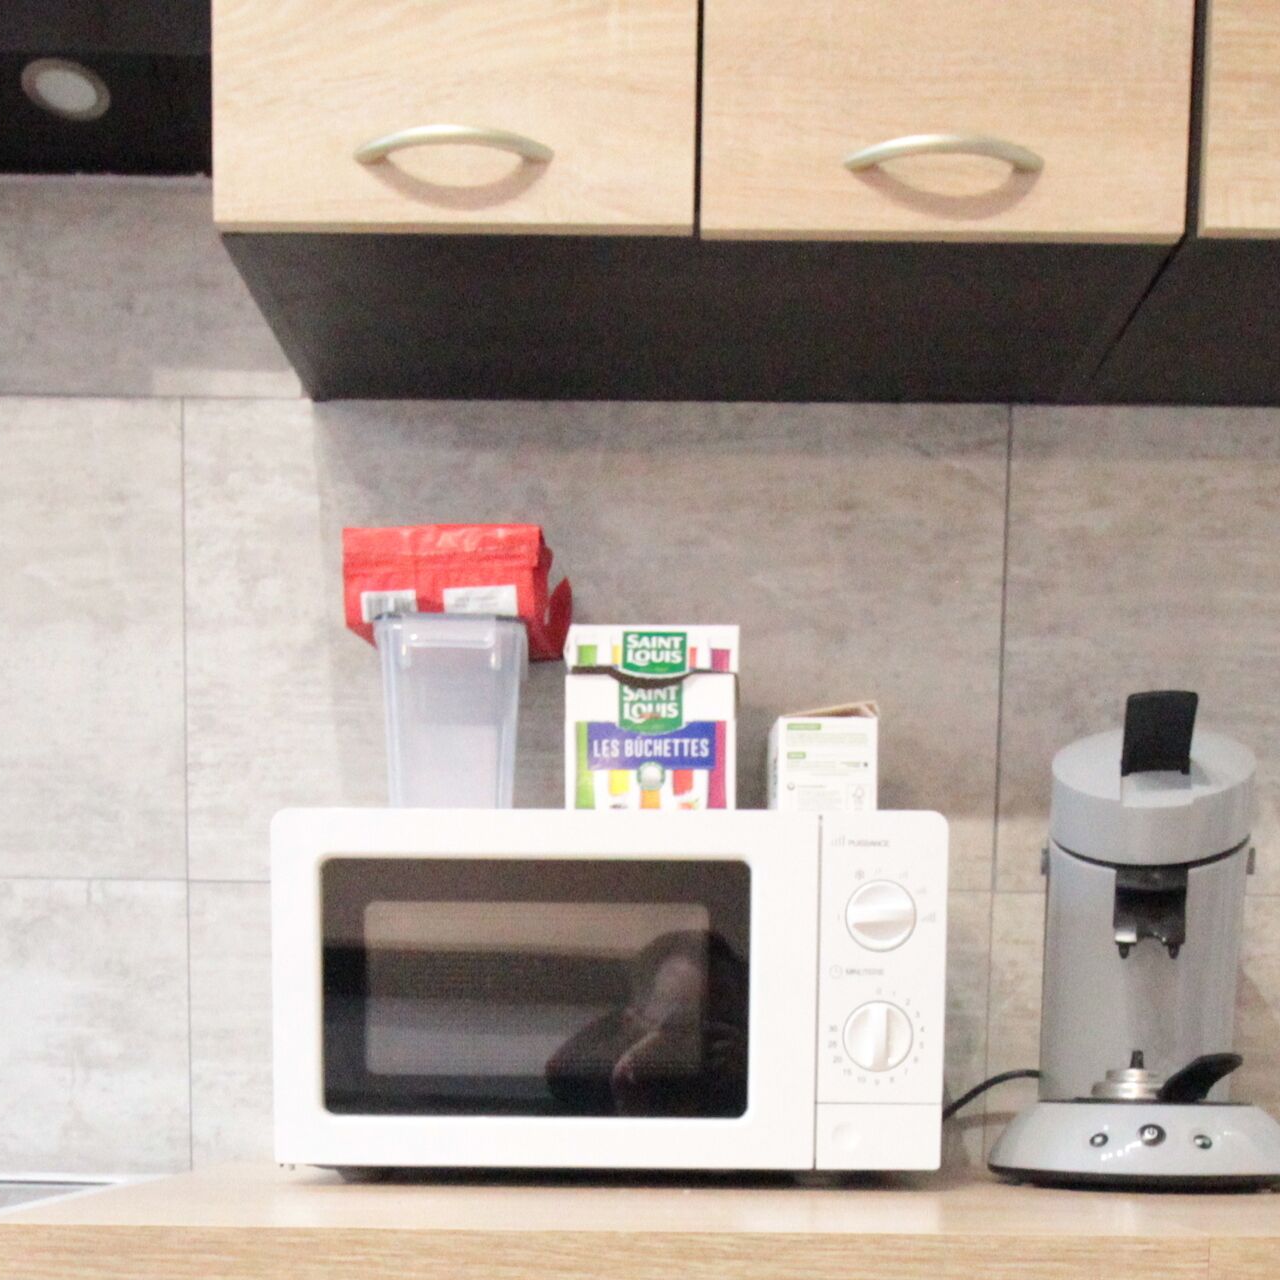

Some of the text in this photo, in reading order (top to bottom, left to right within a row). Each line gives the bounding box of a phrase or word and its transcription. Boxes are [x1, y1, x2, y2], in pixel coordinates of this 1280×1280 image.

[627, 634, 683, 649] SAINT
[626, 649, 682, 666] LOUIS
[623, 685, 678, 701] SAINT
[623, 702, 679, 723] LOUIS
[593, 739, 620, 757] LES
